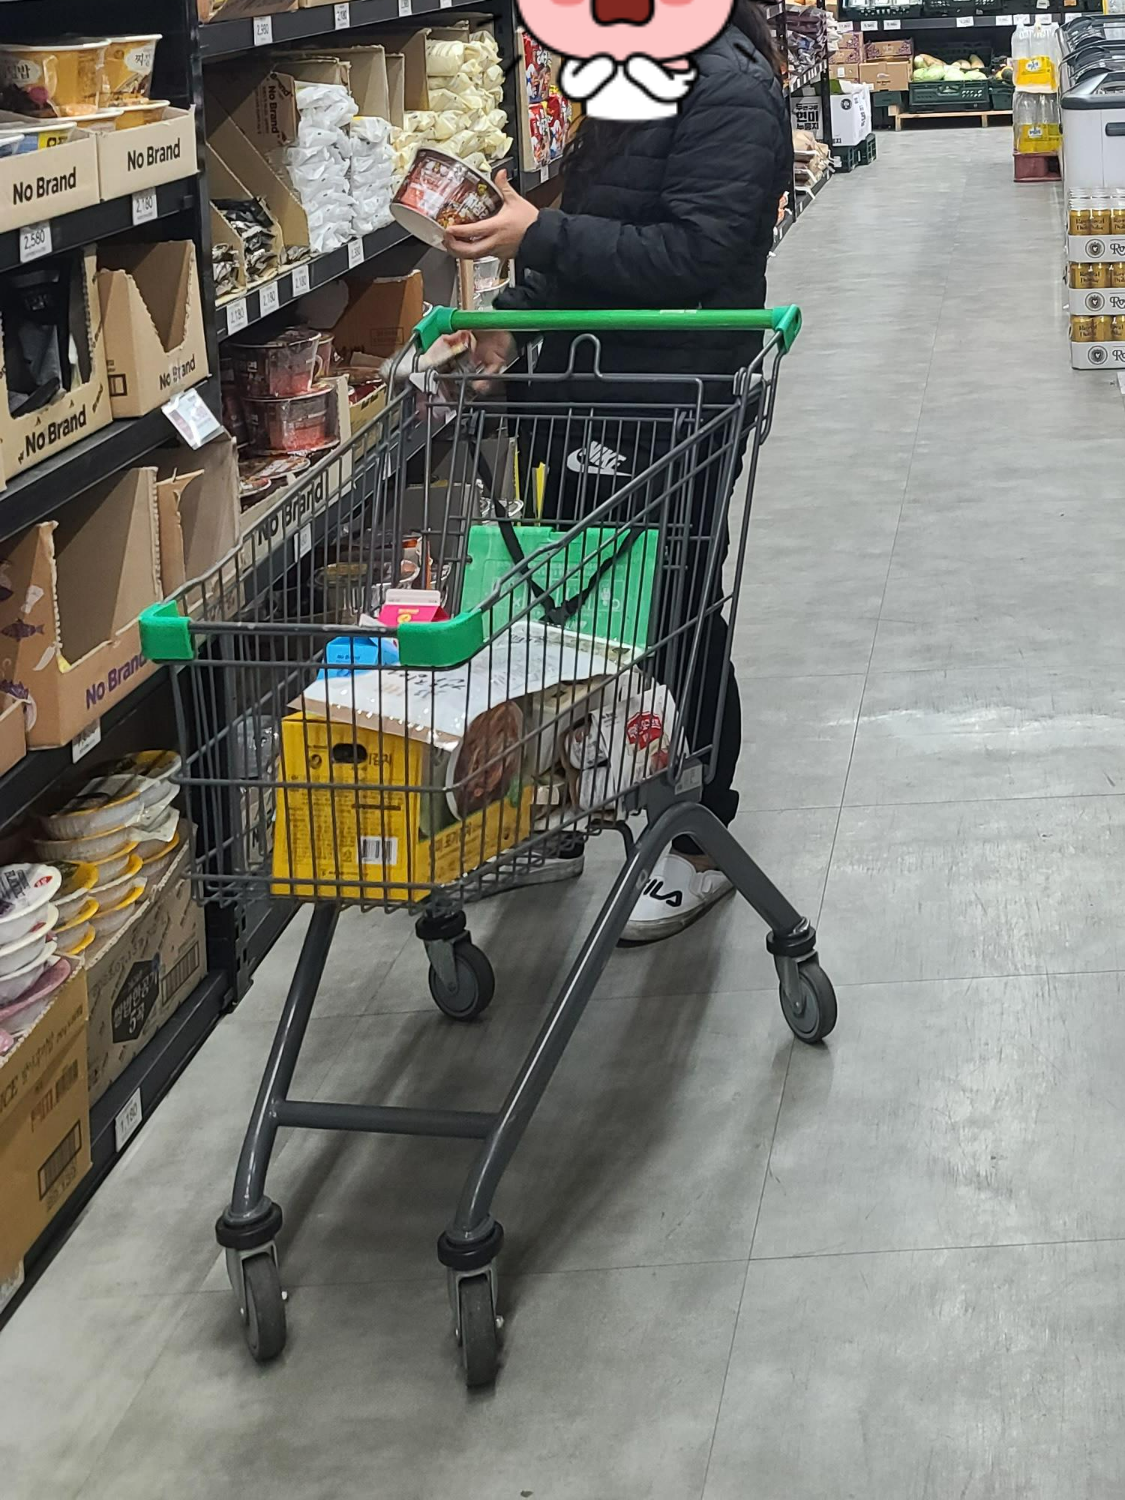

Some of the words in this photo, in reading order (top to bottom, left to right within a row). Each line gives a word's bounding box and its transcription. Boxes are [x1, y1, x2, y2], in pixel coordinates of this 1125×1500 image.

[127, 149, 145, 172] No
[146, 137, 181, 167] Brand
[13, 181, 33, 206] No
[36, 166, 77, 199] Brand
[23, 229, 46, 247] 2,580
[159, 372, 172, 390] No
[25, 430, 46, 458] No
[47, 404, 87, 443] Brand
[579, 440, 627, 469] NIKE
[86, 681, 105, 709] No
